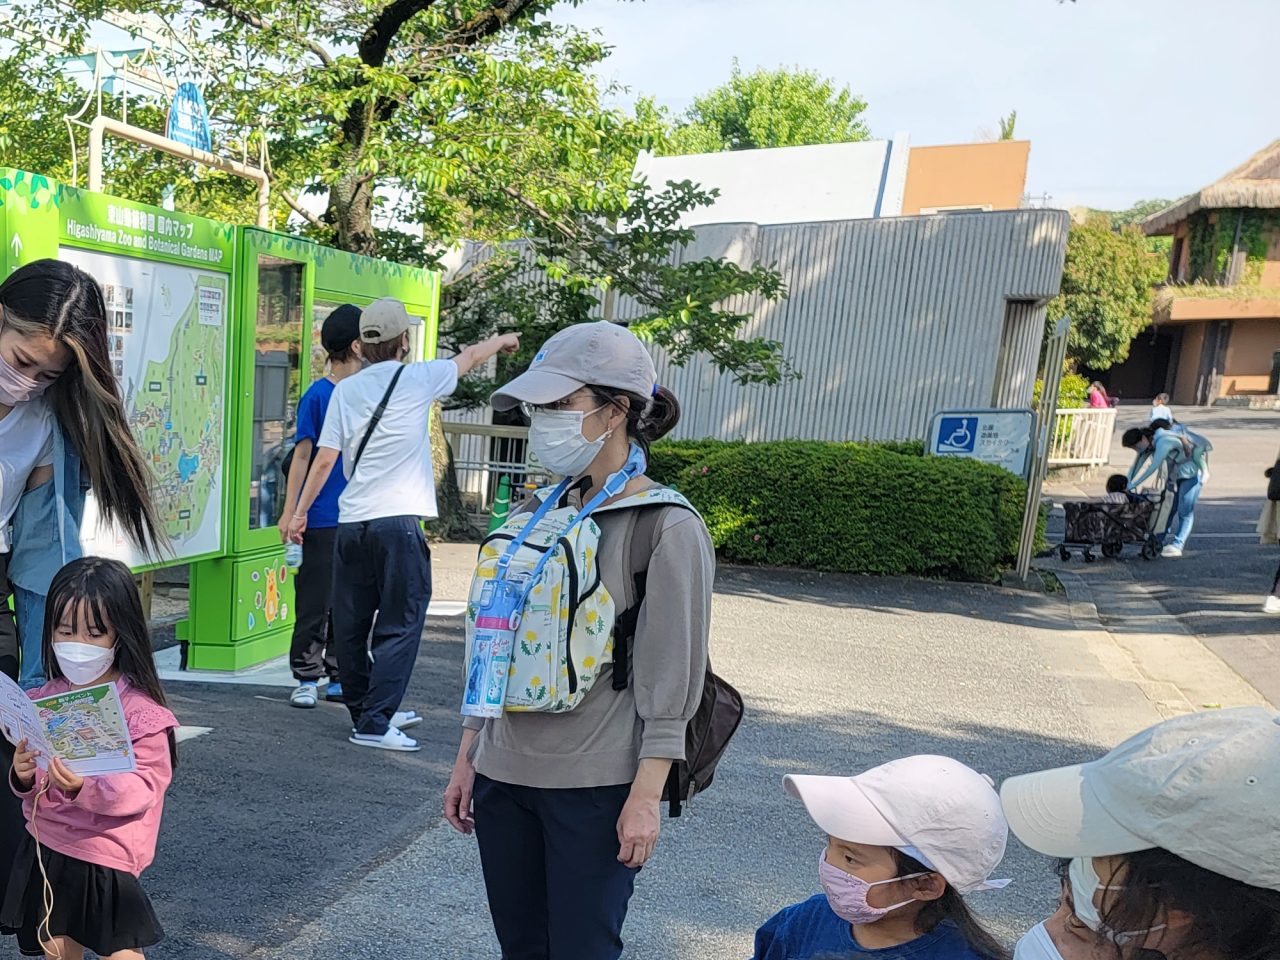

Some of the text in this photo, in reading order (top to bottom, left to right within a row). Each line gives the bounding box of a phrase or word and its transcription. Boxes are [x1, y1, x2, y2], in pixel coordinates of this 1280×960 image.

[67, 218, 117, 243] Higashiyama
[118, 229, 133, 247] Zoo
[133, 235, 147, 249] and
[148, 236, 180, 255] Botanical
[181, 242, 208, 260] Gardens
